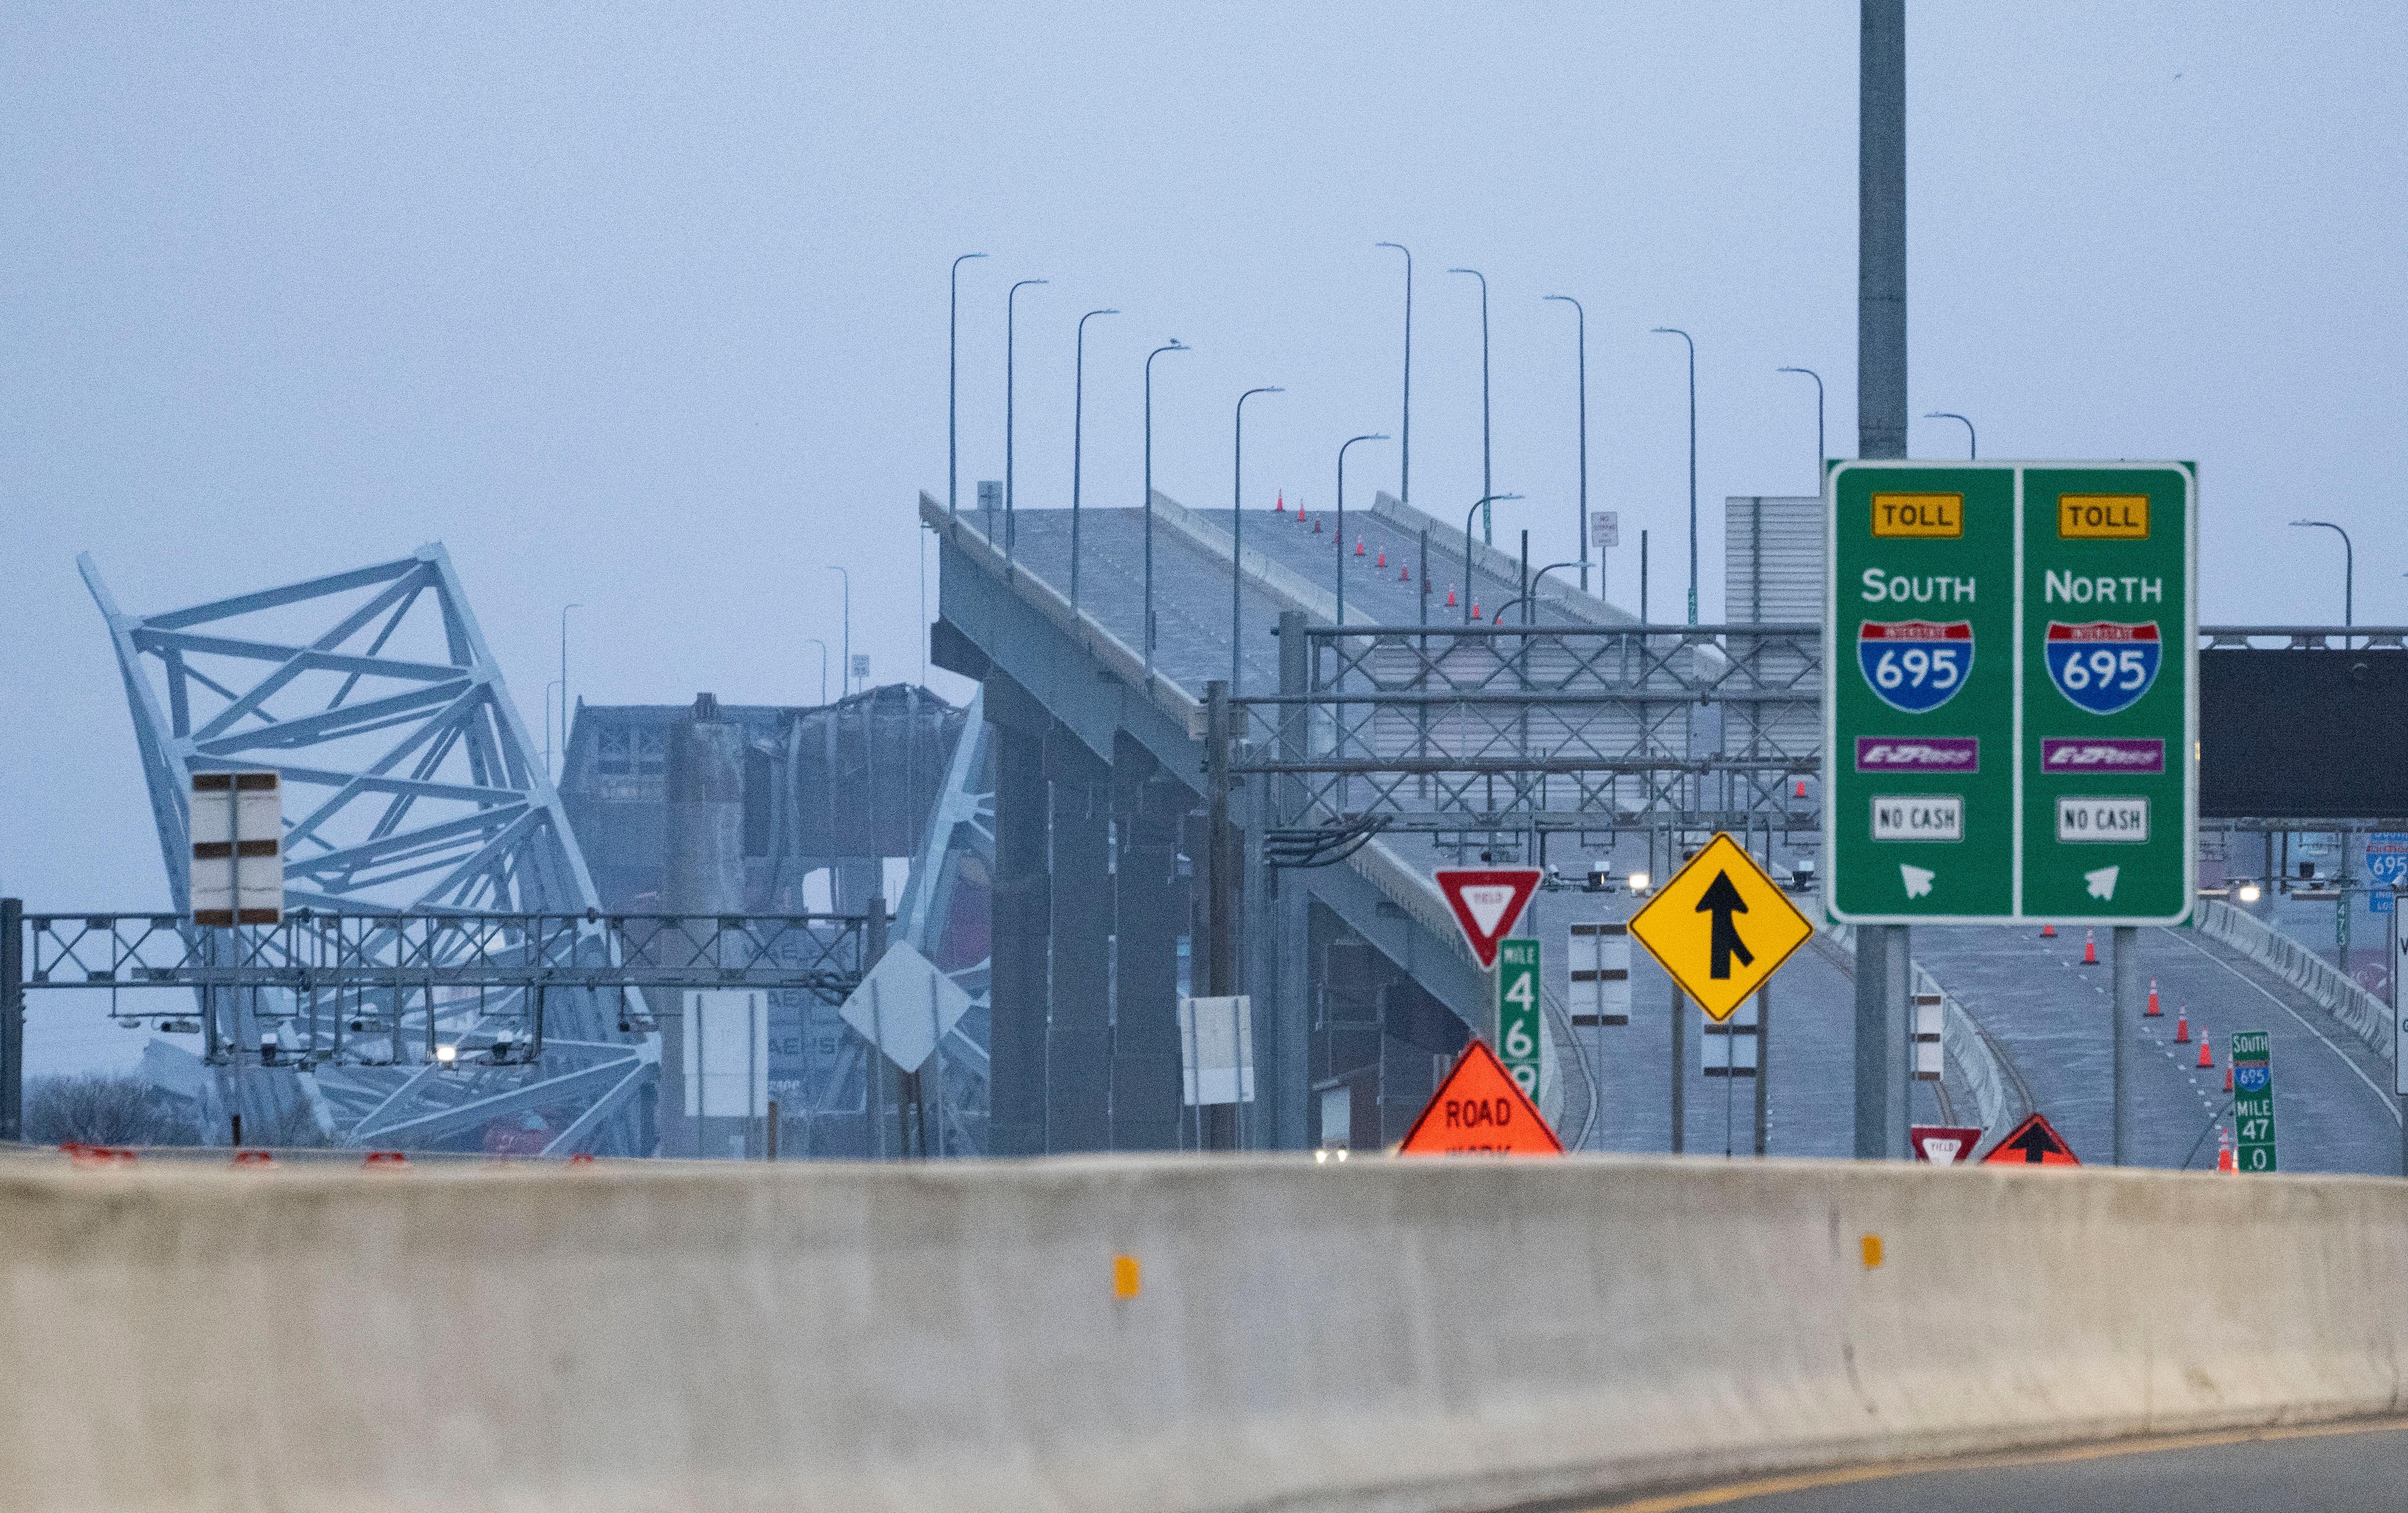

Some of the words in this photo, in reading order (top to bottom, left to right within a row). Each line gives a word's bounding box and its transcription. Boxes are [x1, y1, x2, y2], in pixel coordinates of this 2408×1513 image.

[1883, 505, 1954, 526] TOLL
[2067, 506, 2140, 528] TOLL
[1885, 626, 1946, 638] INTERSTATE
[2071, 626, 2133, 639] INTERSTATE
[1876, 649, 1958, 690] 695
[2063, 650, 2146, 690] 695
[1880, 808, 1902, 829] NO
[1911, 808, 1955, 829] CASH
[2064, 809, 2088, 830] NO
[2095, 809, 2141, 830] CASH
[2373, 856, 2408, 875] 695
[1474, 892, 1503, 904] YIELD
[1504, 947, 1535, 964] MILE
[2233, 1035, 2269, 1053] SOUTH
[1512, 1065, 1537, 1097] 9
[2240, 1069, 2265, 1085] 695
[1446, 1098, 1511, 1128] ROAD
[2237, 1100, 2271, 1117] MILE
[2242, 1118, 2269, 1140] 47
[1931, 1142, 1954, 1151] YIELD
